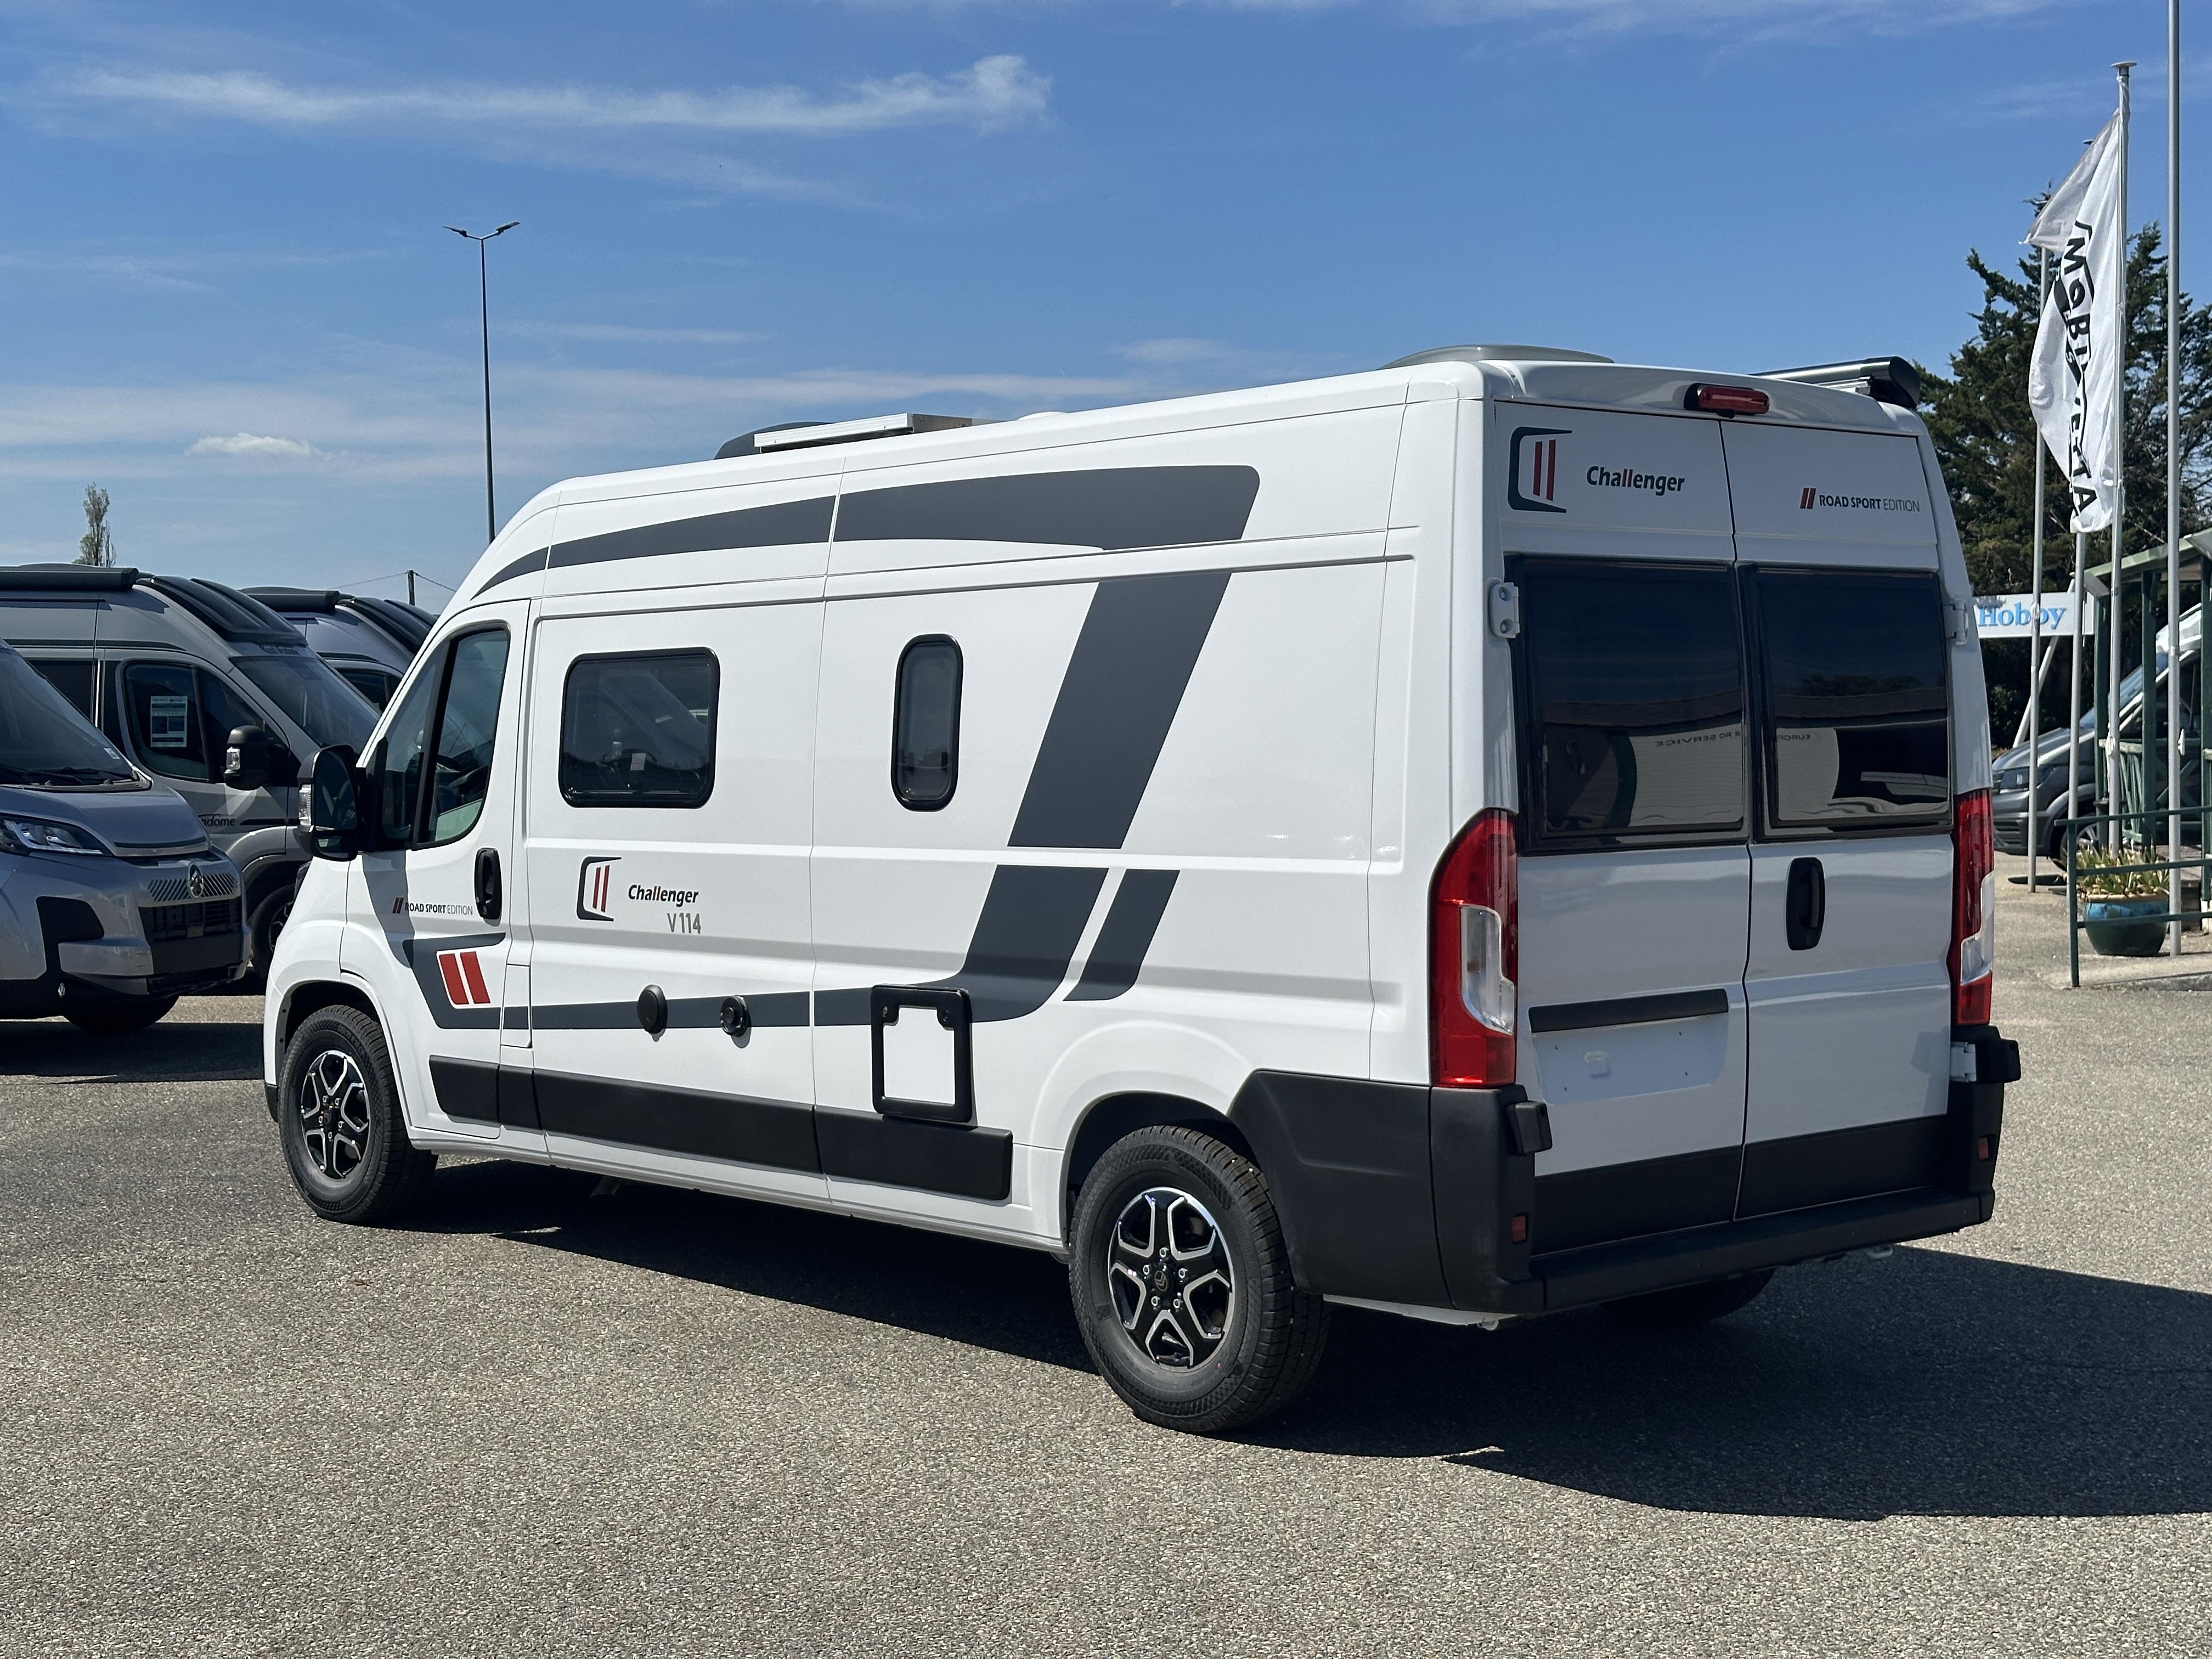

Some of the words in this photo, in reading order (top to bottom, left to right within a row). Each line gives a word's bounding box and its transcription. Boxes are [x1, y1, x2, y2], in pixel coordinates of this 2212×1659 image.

[1587, 466, 1685, 496] Challenger
[1819, 495, 1849, 507] ROAD
[1851, 497, 1881, 509] SPORT
[1883, 499, 1920, 512] EDITION
[628, 884, 699, 907] Challenger
[405, 902, 424, 912] ROAD
[425, 904, 446, 913] SPORT
[447, 905, 473, 915] EDITION
[667, 912, 701, 934] V114
